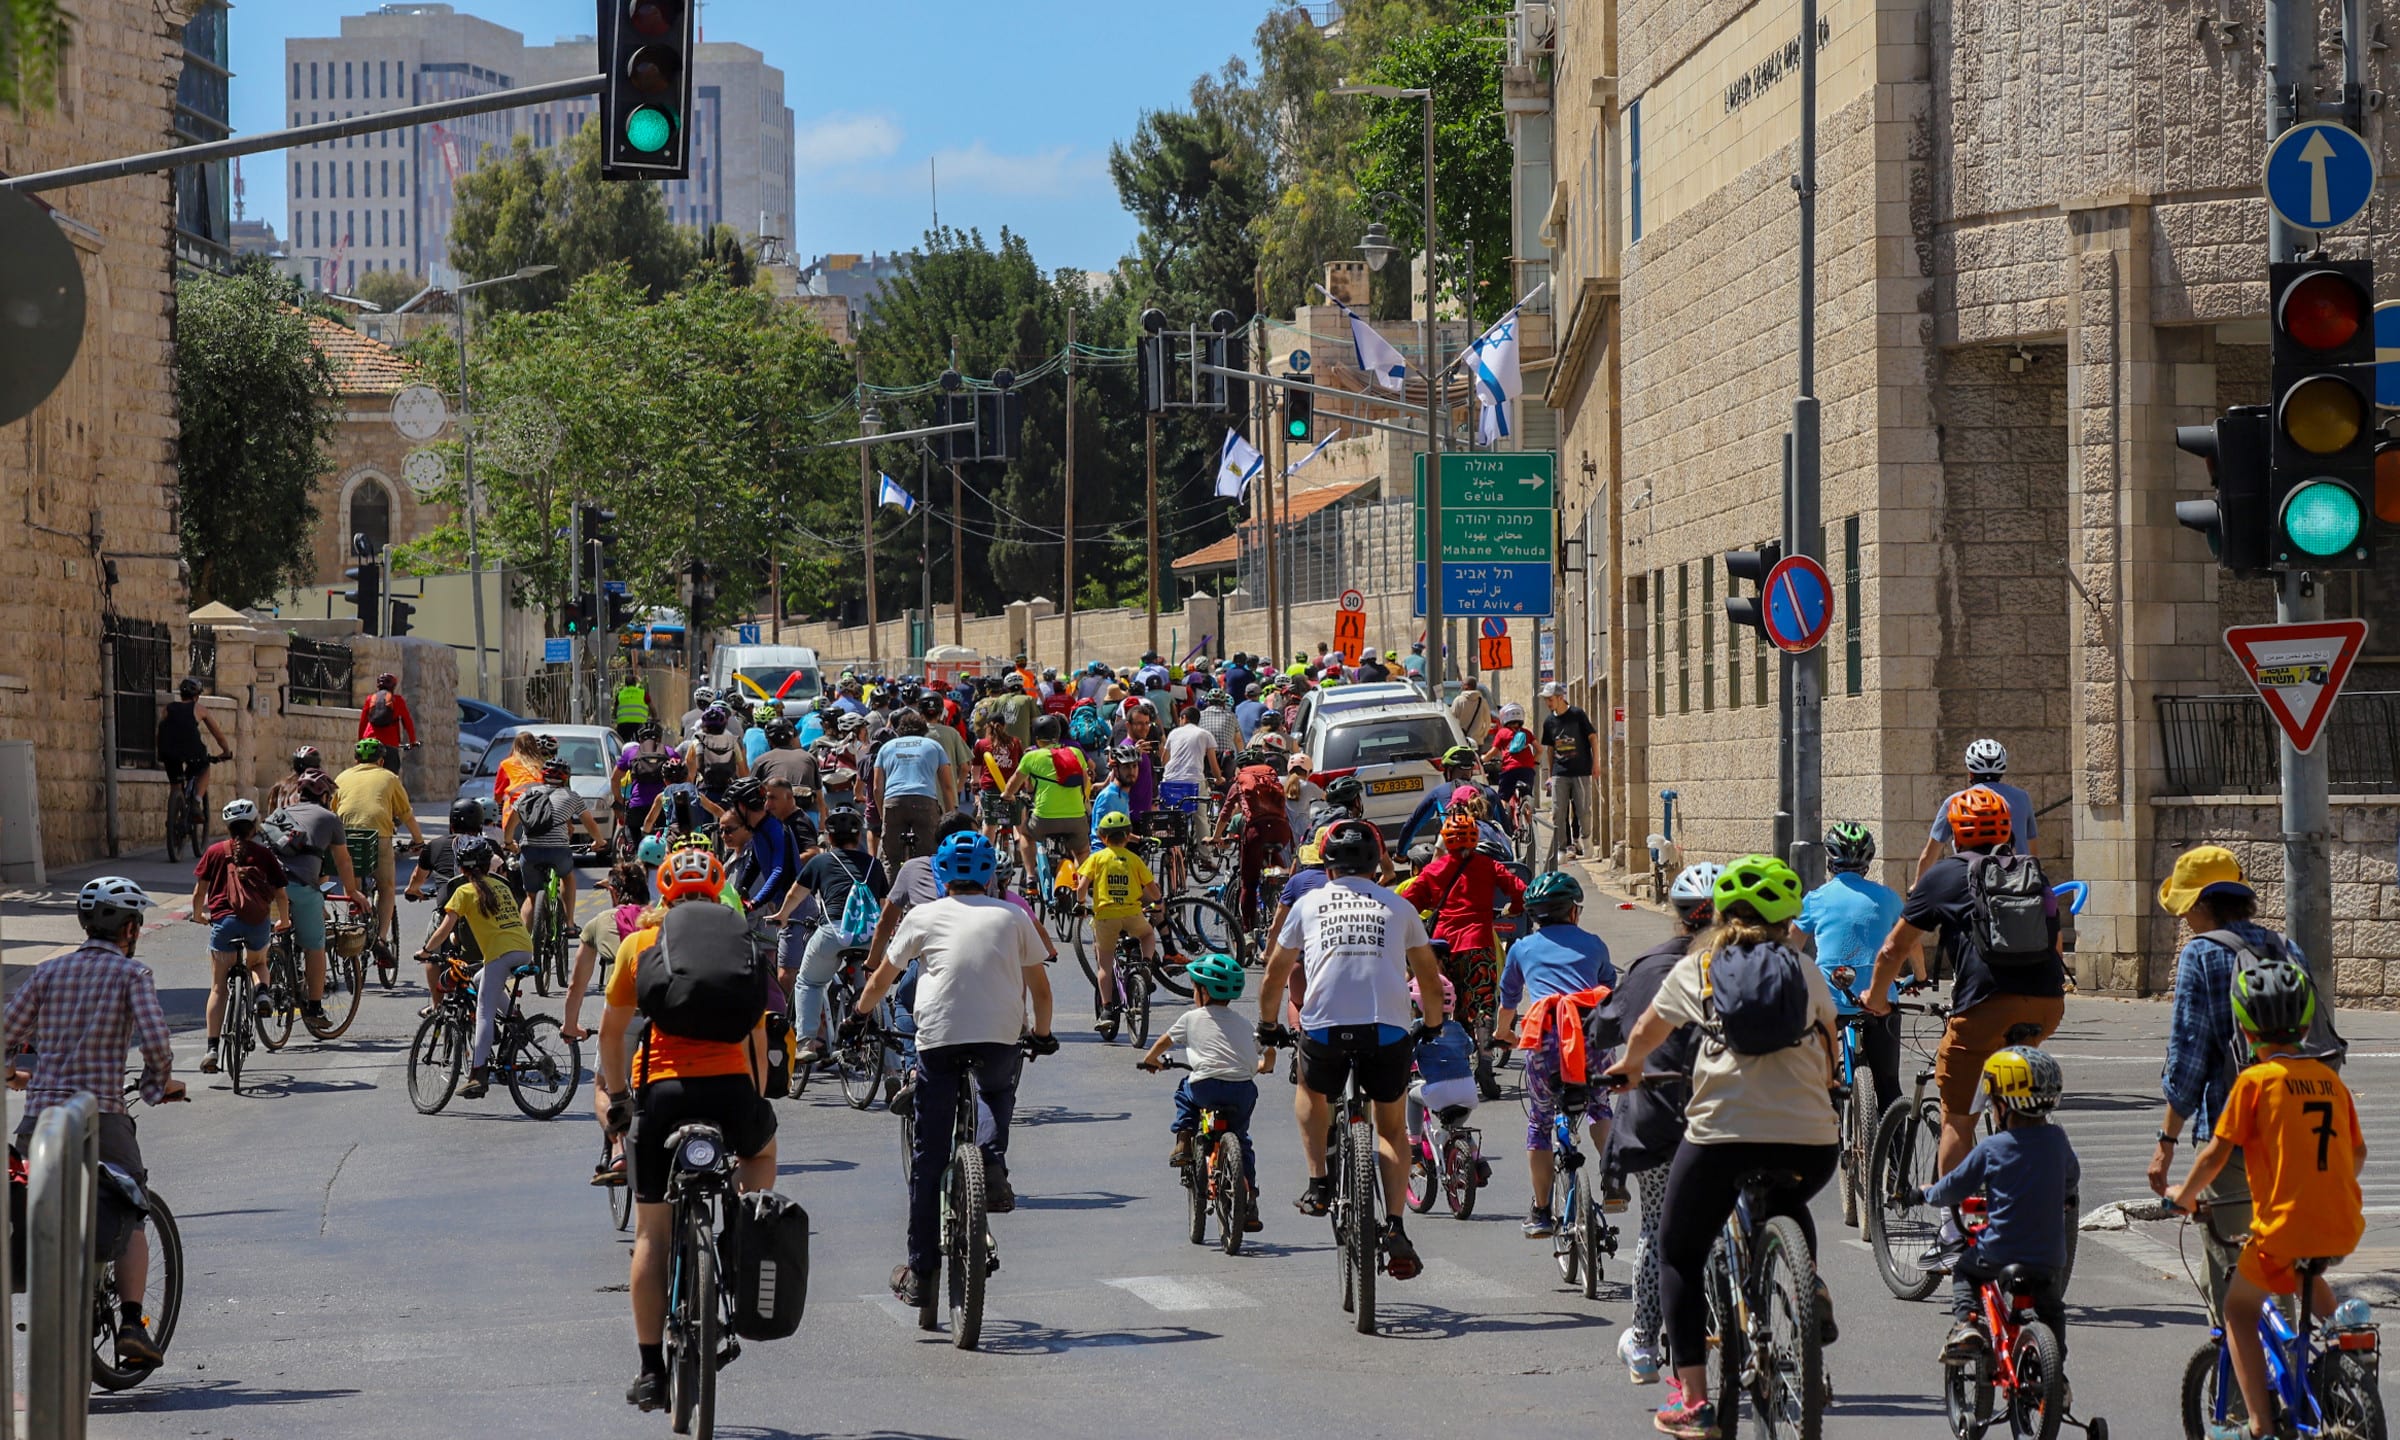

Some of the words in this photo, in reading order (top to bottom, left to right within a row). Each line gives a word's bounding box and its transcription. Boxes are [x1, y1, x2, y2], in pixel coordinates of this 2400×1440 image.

[1464, 459, 1504, 471] גאולה
[1464, 491, 1504, 502] Ge'ula
[1455, 514, 1491, 525] יהודה
[1497, 514, 1534, 526] מחנה
[1443, 545, 1492, 555] Mahane
[1500, 545, 1545, 556] Yehuda
[1455, 568, 1487, 579] אביב
[1493, 566, 1513, 579] תל
[1345, 596, 1359, 608] 30
[1458, 599, 1476, 609] Tel
[1483, 599, 1510, 609] Aviv
[1320, 913, 1386, 930] RUNNING
[1320, 924, 1344, 940] FOR
[1348, 924, 1385, 936] THEIR
[1321, 934, 1385, 951] RELEASE
[2284, 1079, 2316, 1096] VINI
[2303, 1101, 2338, 1172] 7
